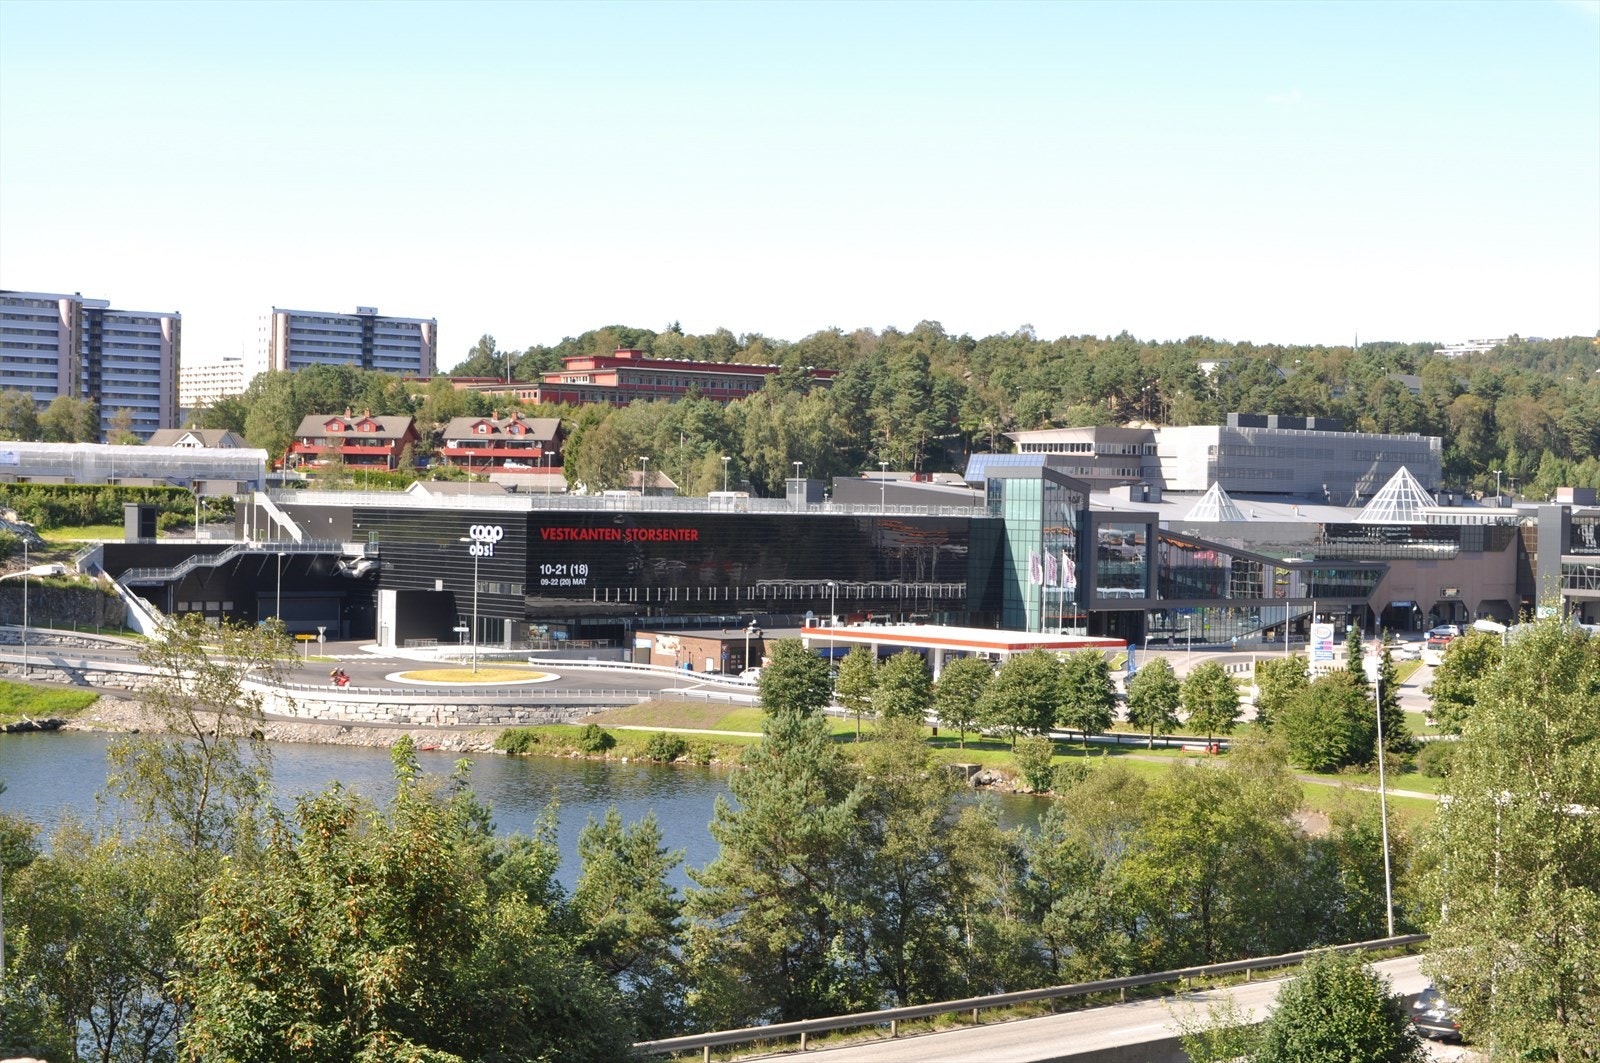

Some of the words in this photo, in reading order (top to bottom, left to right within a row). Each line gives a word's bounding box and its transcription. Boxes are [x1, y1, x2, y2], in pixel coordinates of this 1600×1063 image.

[469, 525, 503, 543] coop
[540, 528, 621, 540] VESTKANTEN
[625, 528, 698, 541] STORSENTER
[469, 542, 493, 557] obs!
[540, 564, 567, 575] 10-21
[570, 564, 589, 577] (18)
[540, 578, 559, 586] 09-22
[560, 578, 571, 587] (20)
[572, 578, 587, 586] MAT
